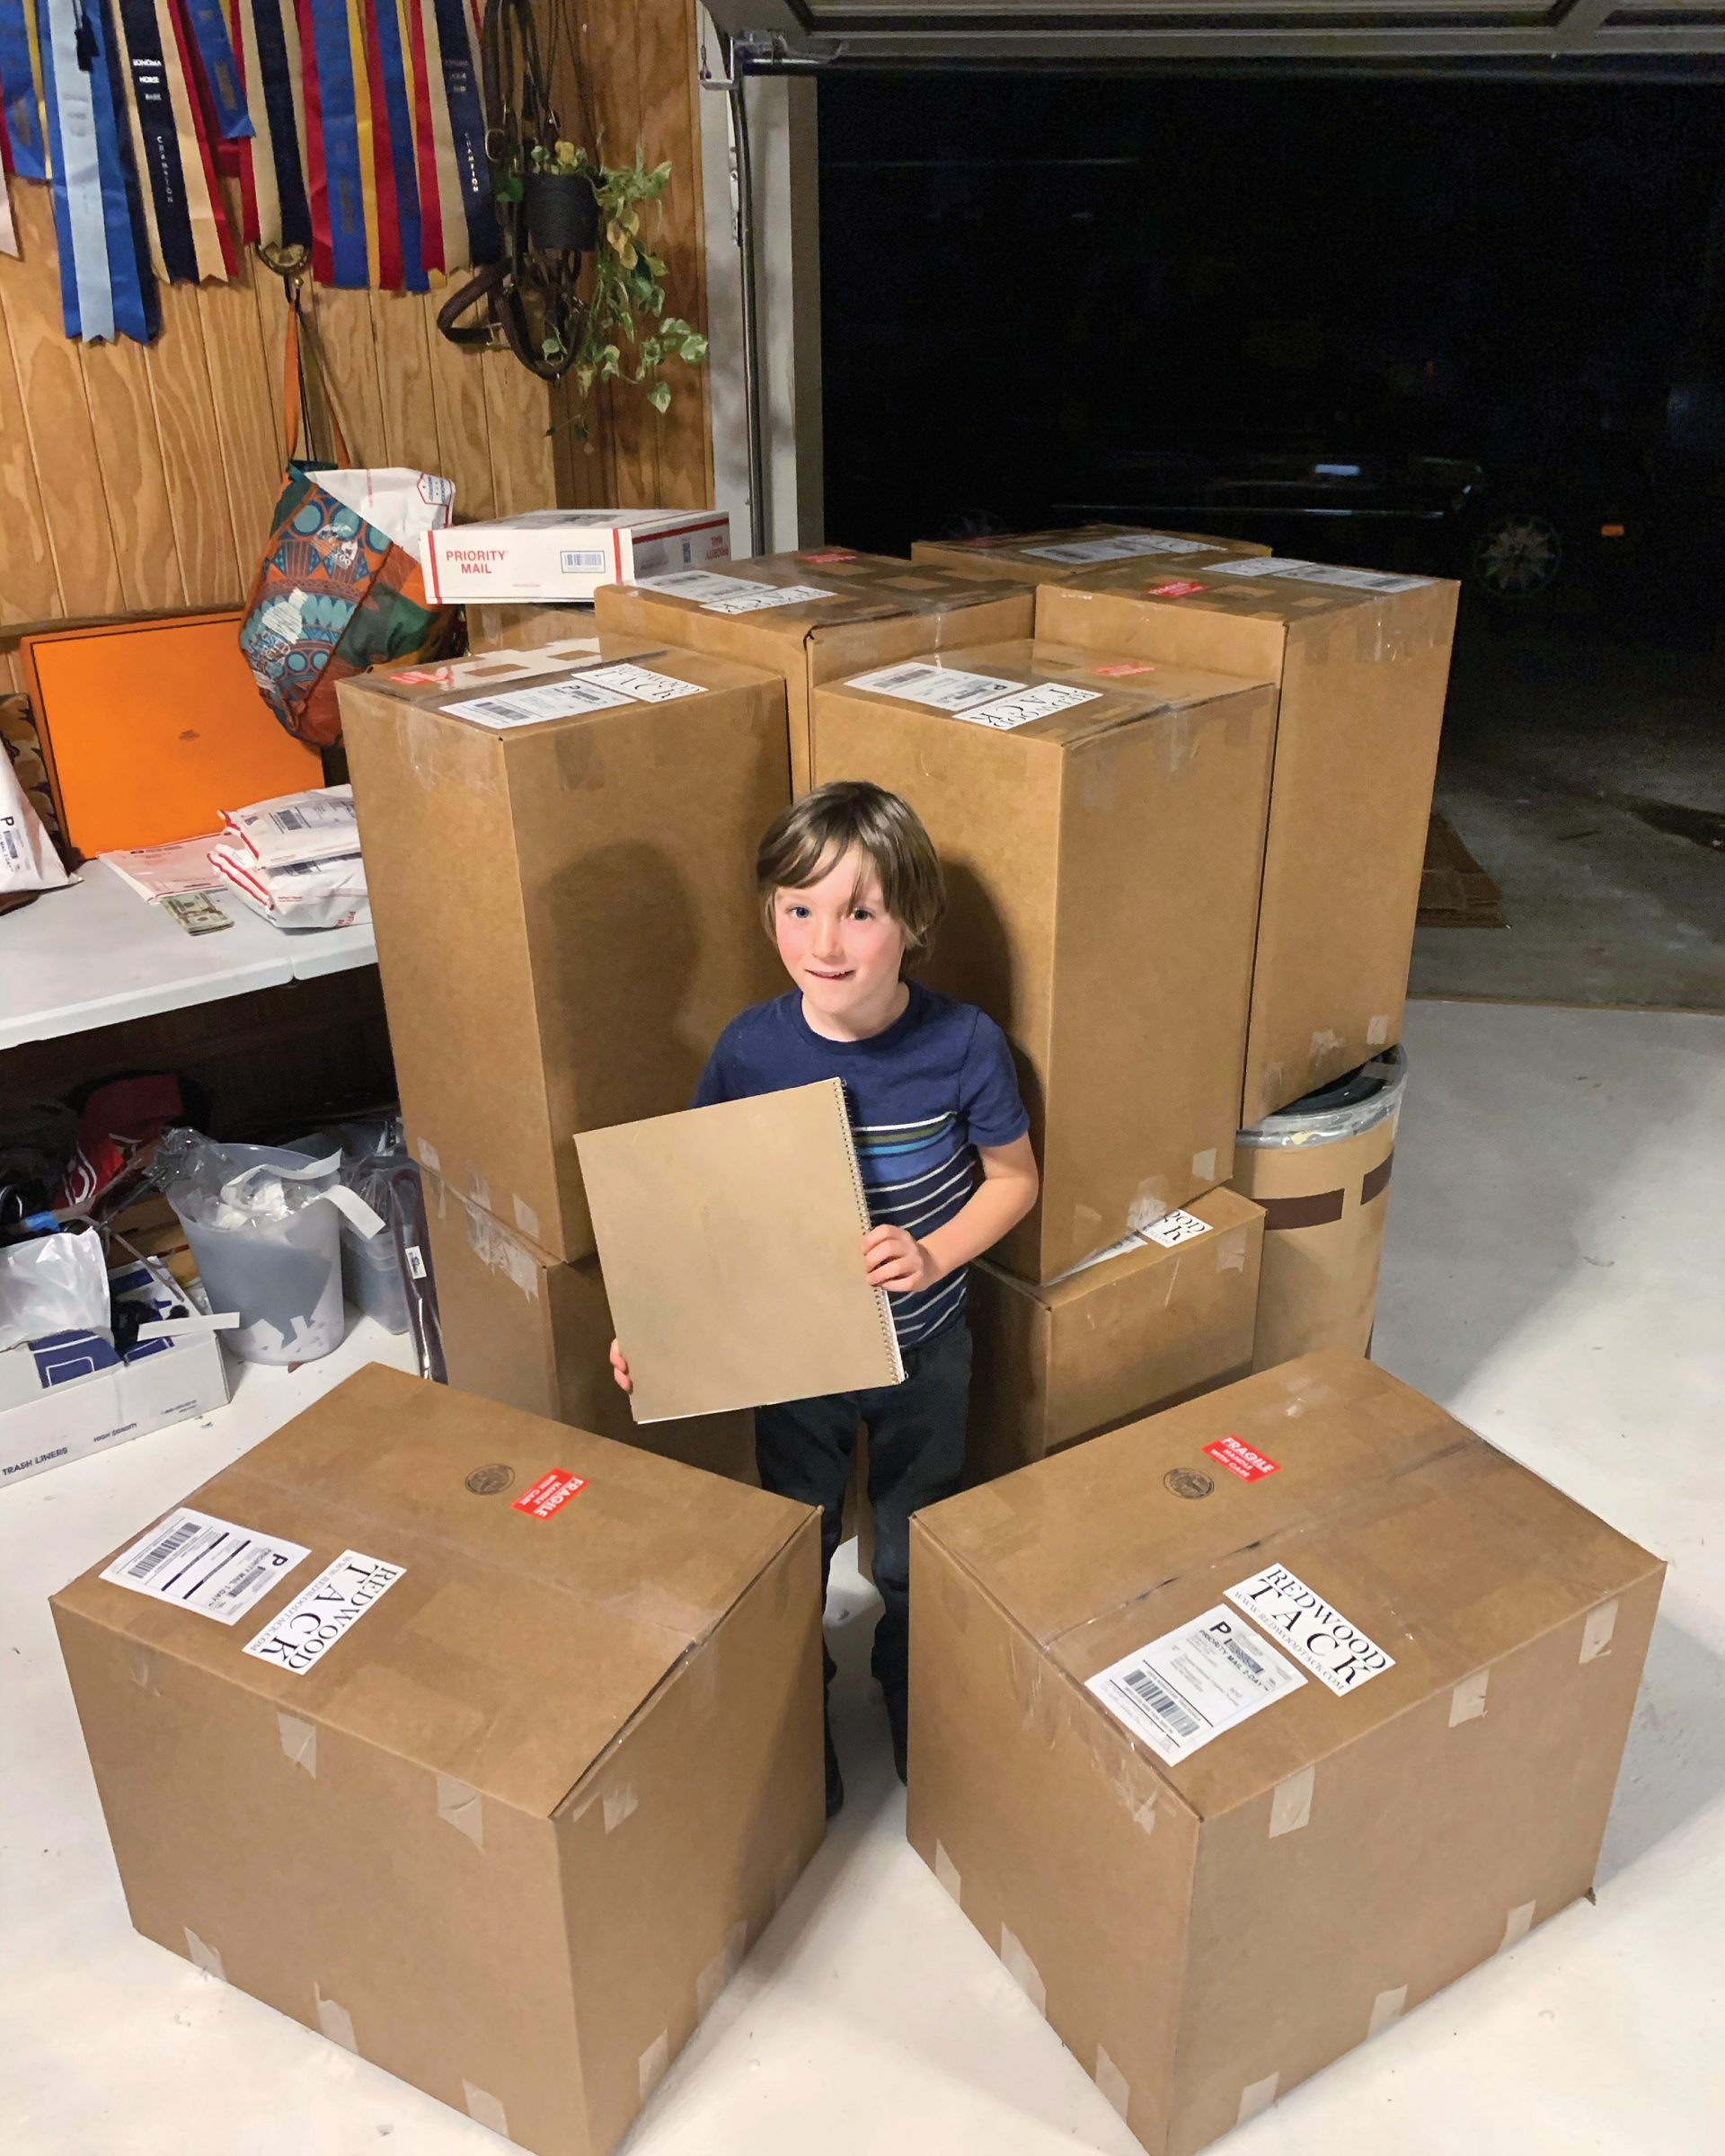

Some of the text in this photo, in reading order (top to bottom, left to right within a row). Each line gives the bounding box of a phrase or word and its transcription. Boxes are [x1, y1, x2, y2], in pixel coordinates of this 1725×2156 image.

[446, 551, 505, 561] PRIORITY
[461, 563, 492, 574] MAIL
[0, 816, 14, 826] P
[2, 1446, 68, 1476] TRASH LINERS
[1220, 1436, 1276, 1473] FRAGILE
[533, 1476, 584, 1518] FRAGILE
[242, 1548, 272, 1572] PRIORITY
[271, 1552, 288, 1568] P
[228, 1571, 245, 1585] MAIL
[259, 1557, 379, 1662] TACK
[284, 1567, 398, 1671] REDWOOD
[1265, 1568, 1390, 1671] REDWOOD
[1210, 1621, 1231, 1638] P
[1242, 1577, 1371, 1684] TACK
[1198, 1629, 1228, 1655] PRIORITY
[1225, 1655, 1243, 1670] MAIL
